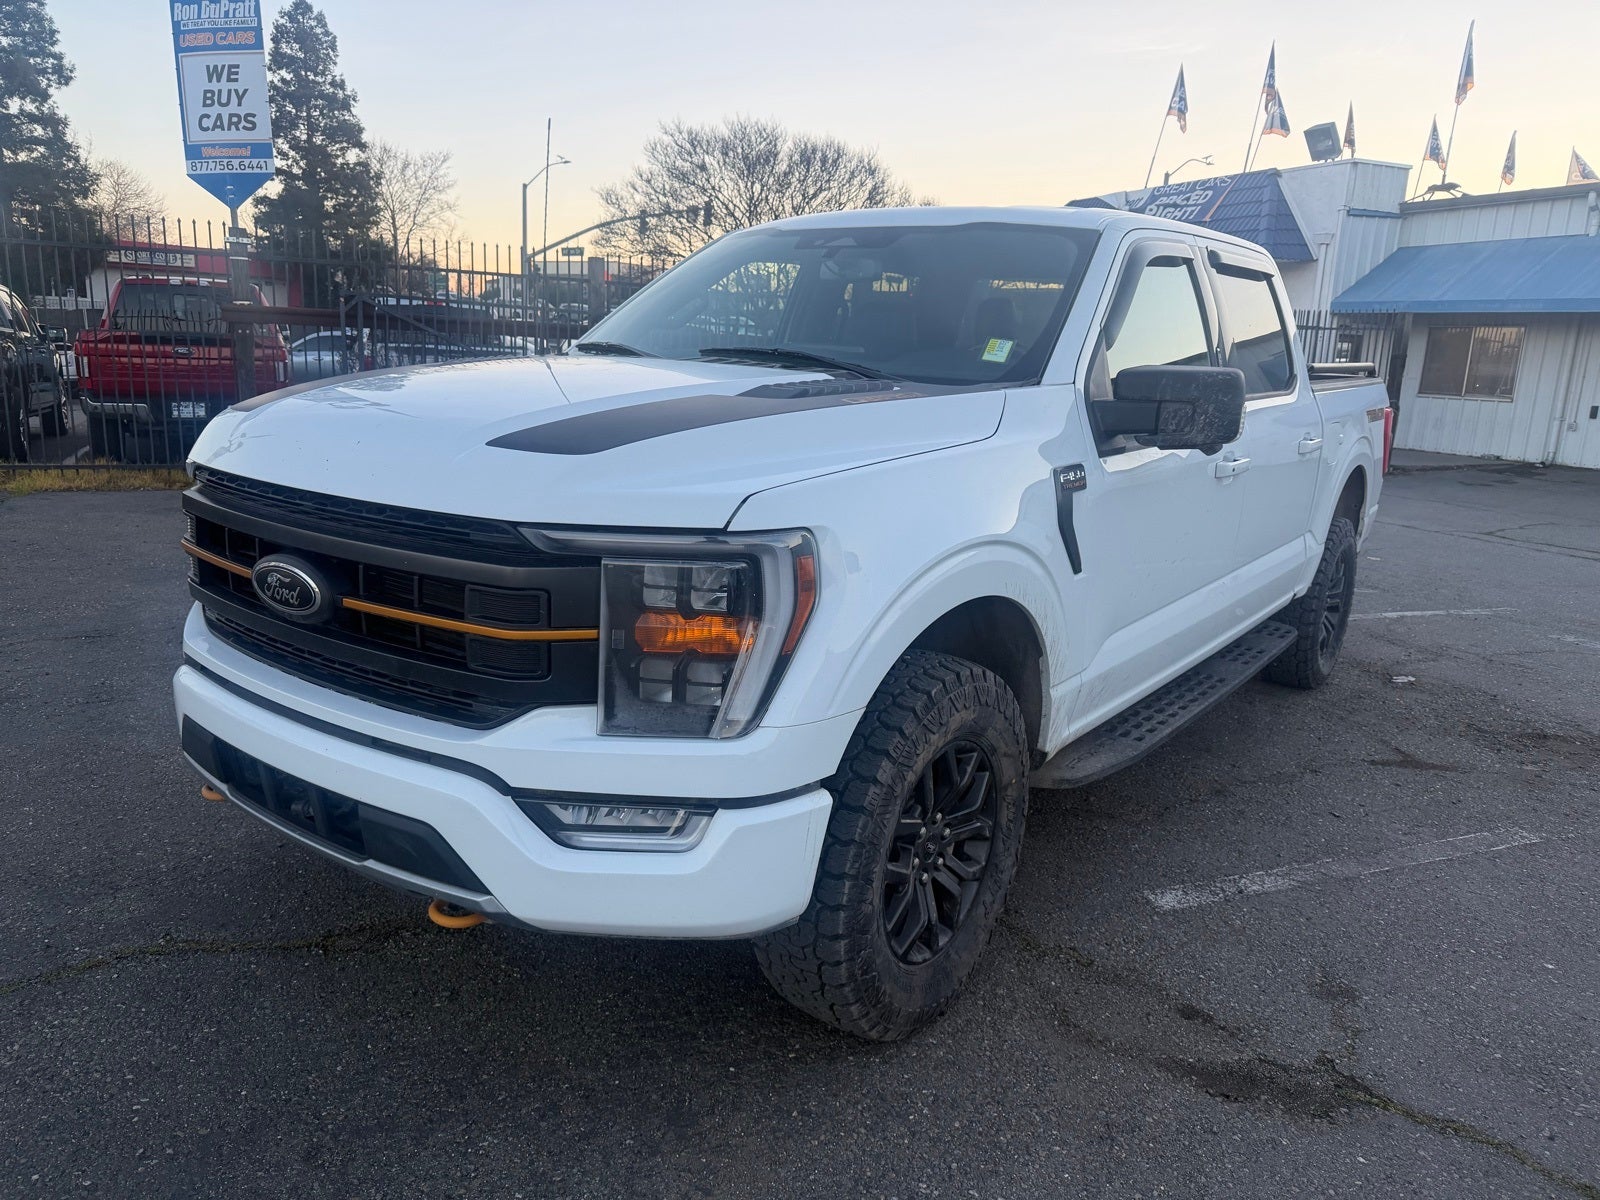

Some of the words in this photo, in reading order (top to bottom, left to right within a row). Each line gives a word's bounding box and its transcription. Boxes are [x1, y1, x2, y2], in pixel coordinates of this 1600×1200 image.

[173, 3, 198, 21] Ron
[201, 0, 256, 19] DuPratt
[191, 20, 206, 28] TREAT
[233, 18, 256, 26] FAMILY!
[180, 33, 214, 47] USED
[215, 31, 256, 45] CARS
[206, 64, 240, 83] WE
[202, 88, 249, 108] BUY
[198, 113, 257, 132] CARS
[201, 146, 251, 158] Welcome!
[190, 160, 268, 172] 877.756.6441
[1154, 182, 1193, 195] GREAT
[1196, 176, 1231, 189] CARS
[264, 572, 301, 605] Ford
